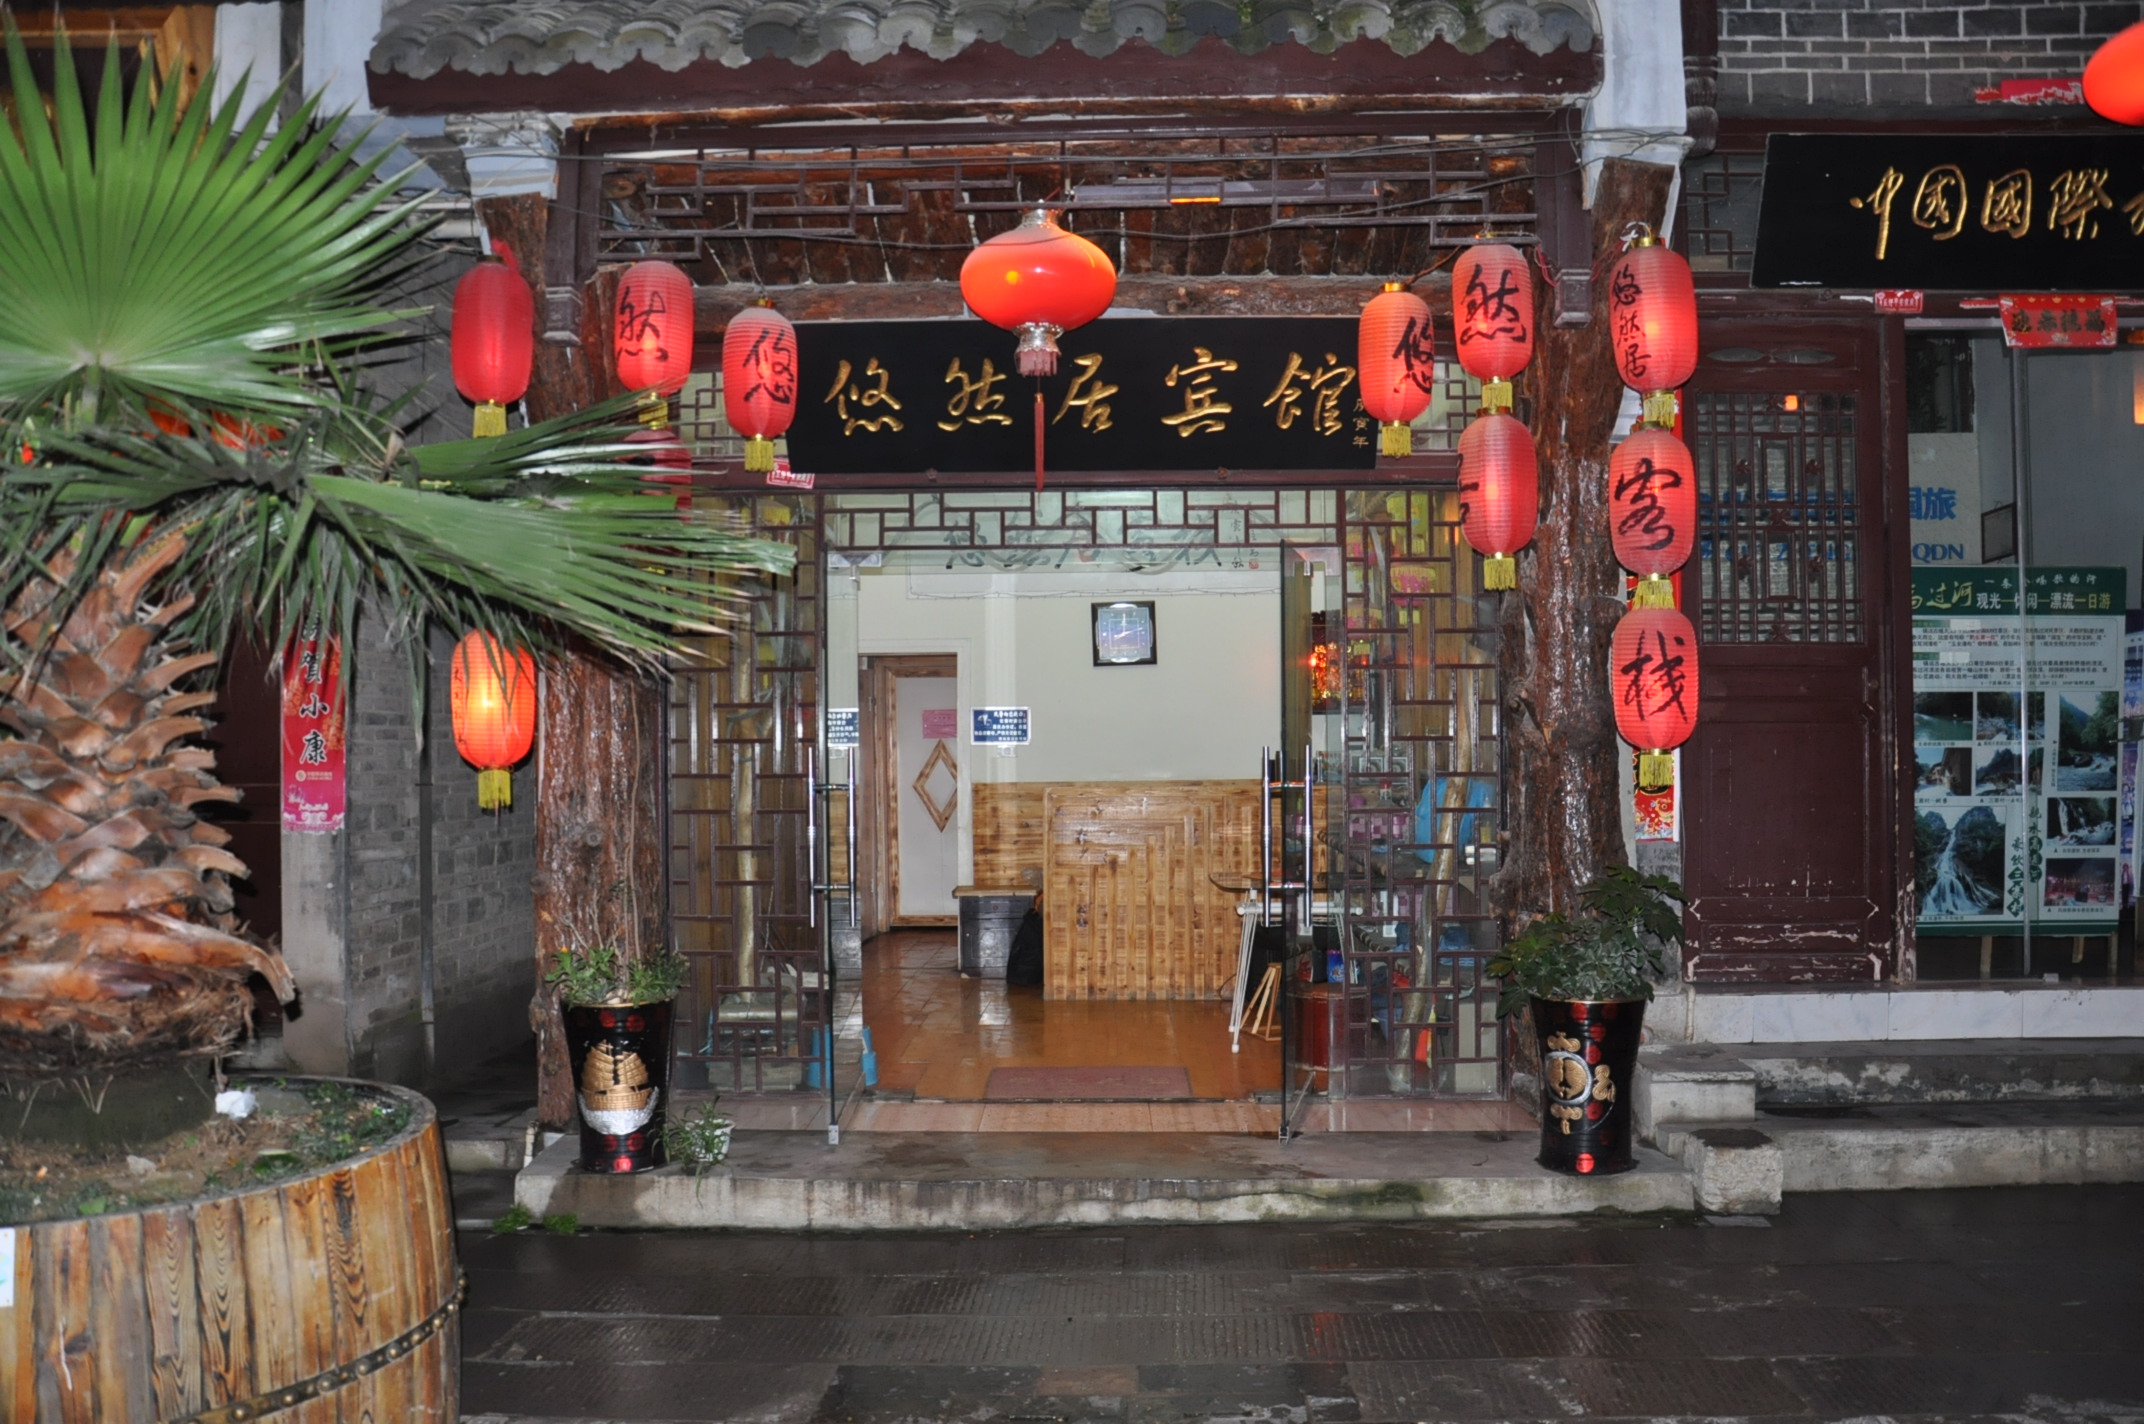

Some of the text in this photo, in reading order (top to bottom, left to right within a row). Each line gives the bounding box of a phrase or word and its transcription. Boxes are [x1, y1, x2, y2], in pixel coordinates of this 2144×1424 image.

[1612, 263, 1652, 379] 悠然居
[1912, 542, 1964, 564] QDN
